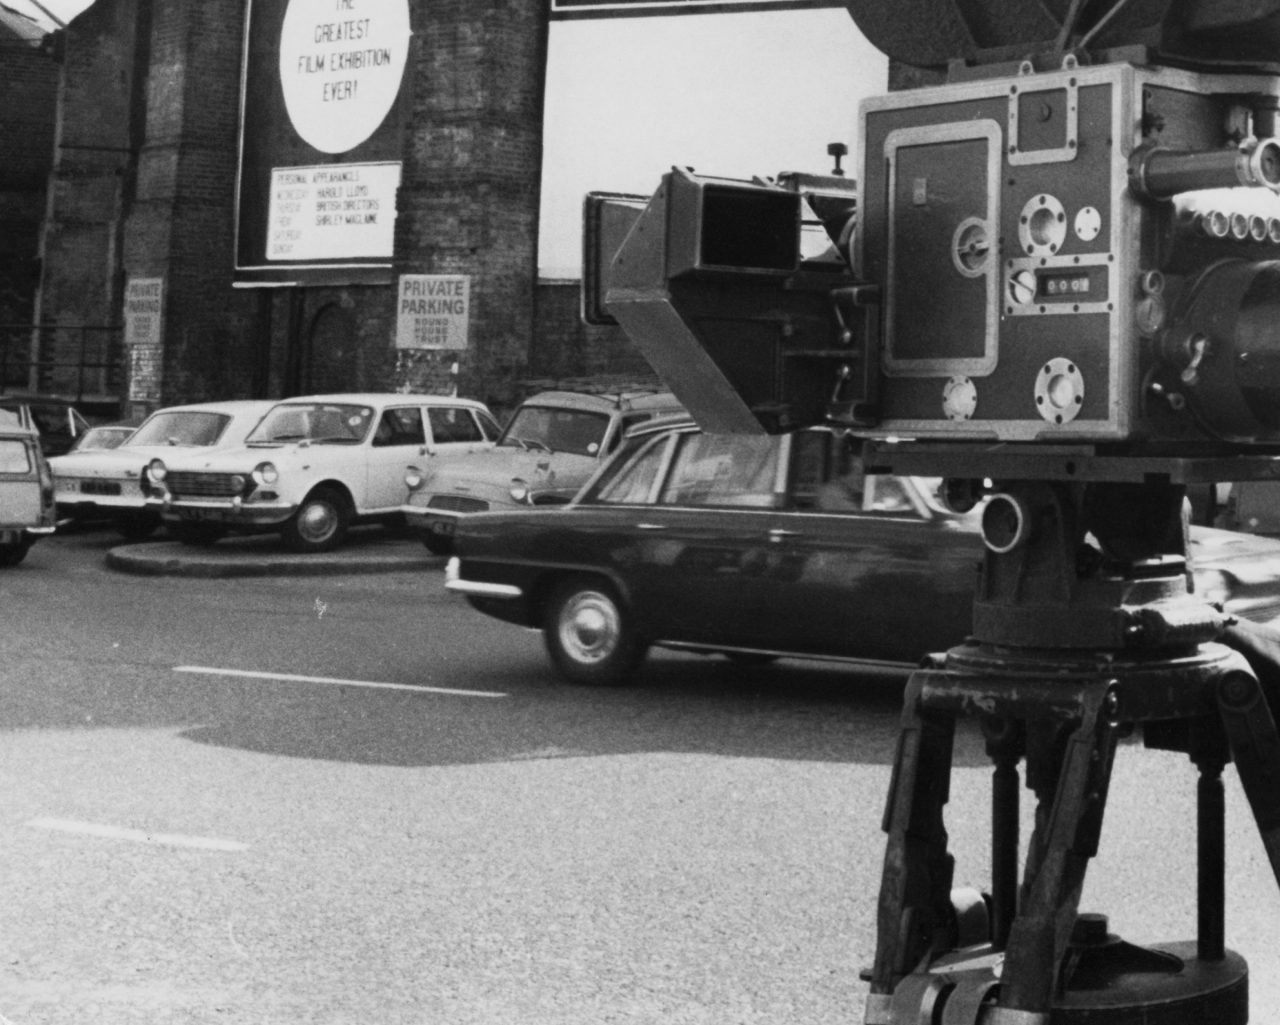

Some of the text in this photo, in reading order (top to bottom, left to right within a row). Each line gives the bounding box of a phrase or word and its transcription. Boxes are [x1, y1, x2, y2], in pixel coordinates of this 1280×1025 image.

[314, 18, 370, 44] GREATEST
[298, 48, 391, 74] FILM EXHIBITION
[323, 80, 358, 102] EVER!
[404, 280, 464, 296] PRIVATE
[400, 300, 464, 314] PARKING
